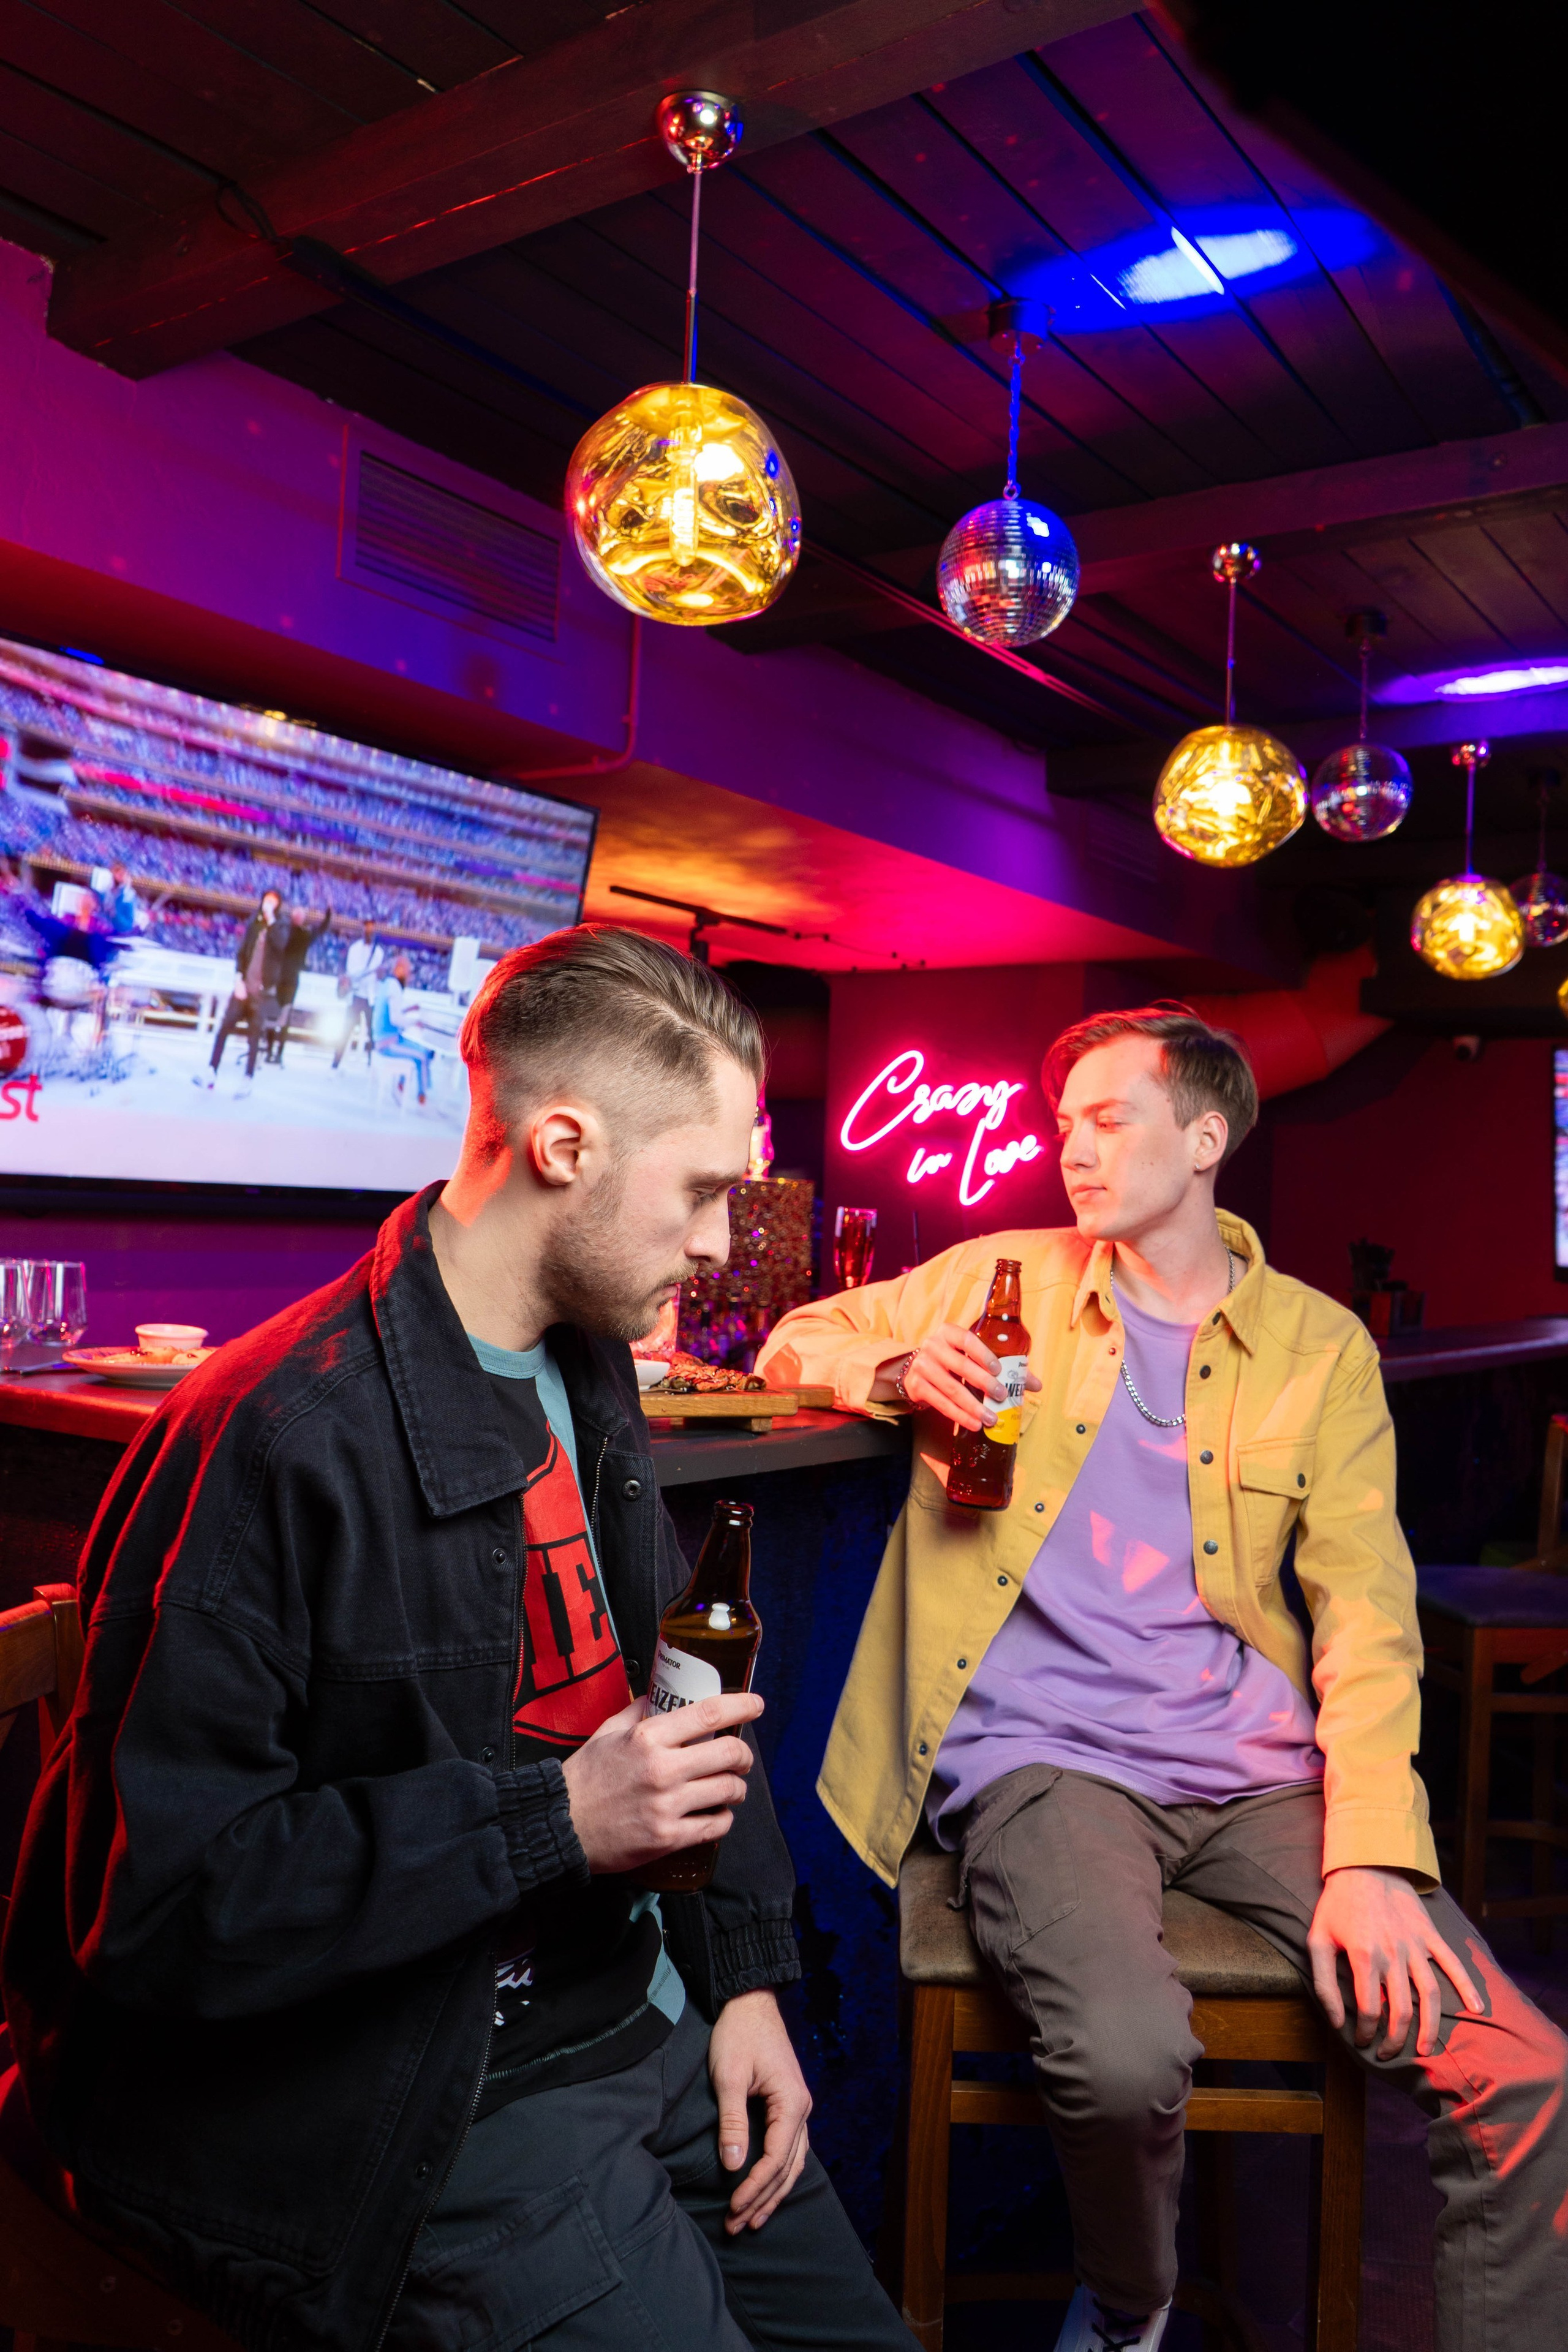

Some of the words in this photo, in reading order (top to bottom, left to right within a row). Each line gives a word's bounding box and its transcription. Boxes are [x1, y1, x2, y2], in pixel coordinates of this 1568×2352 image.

[840, 1050, 1025, 1151] Crazy
[907, 1147, 952, 1183] in
[959, 1117, 1043, 1206] Love
